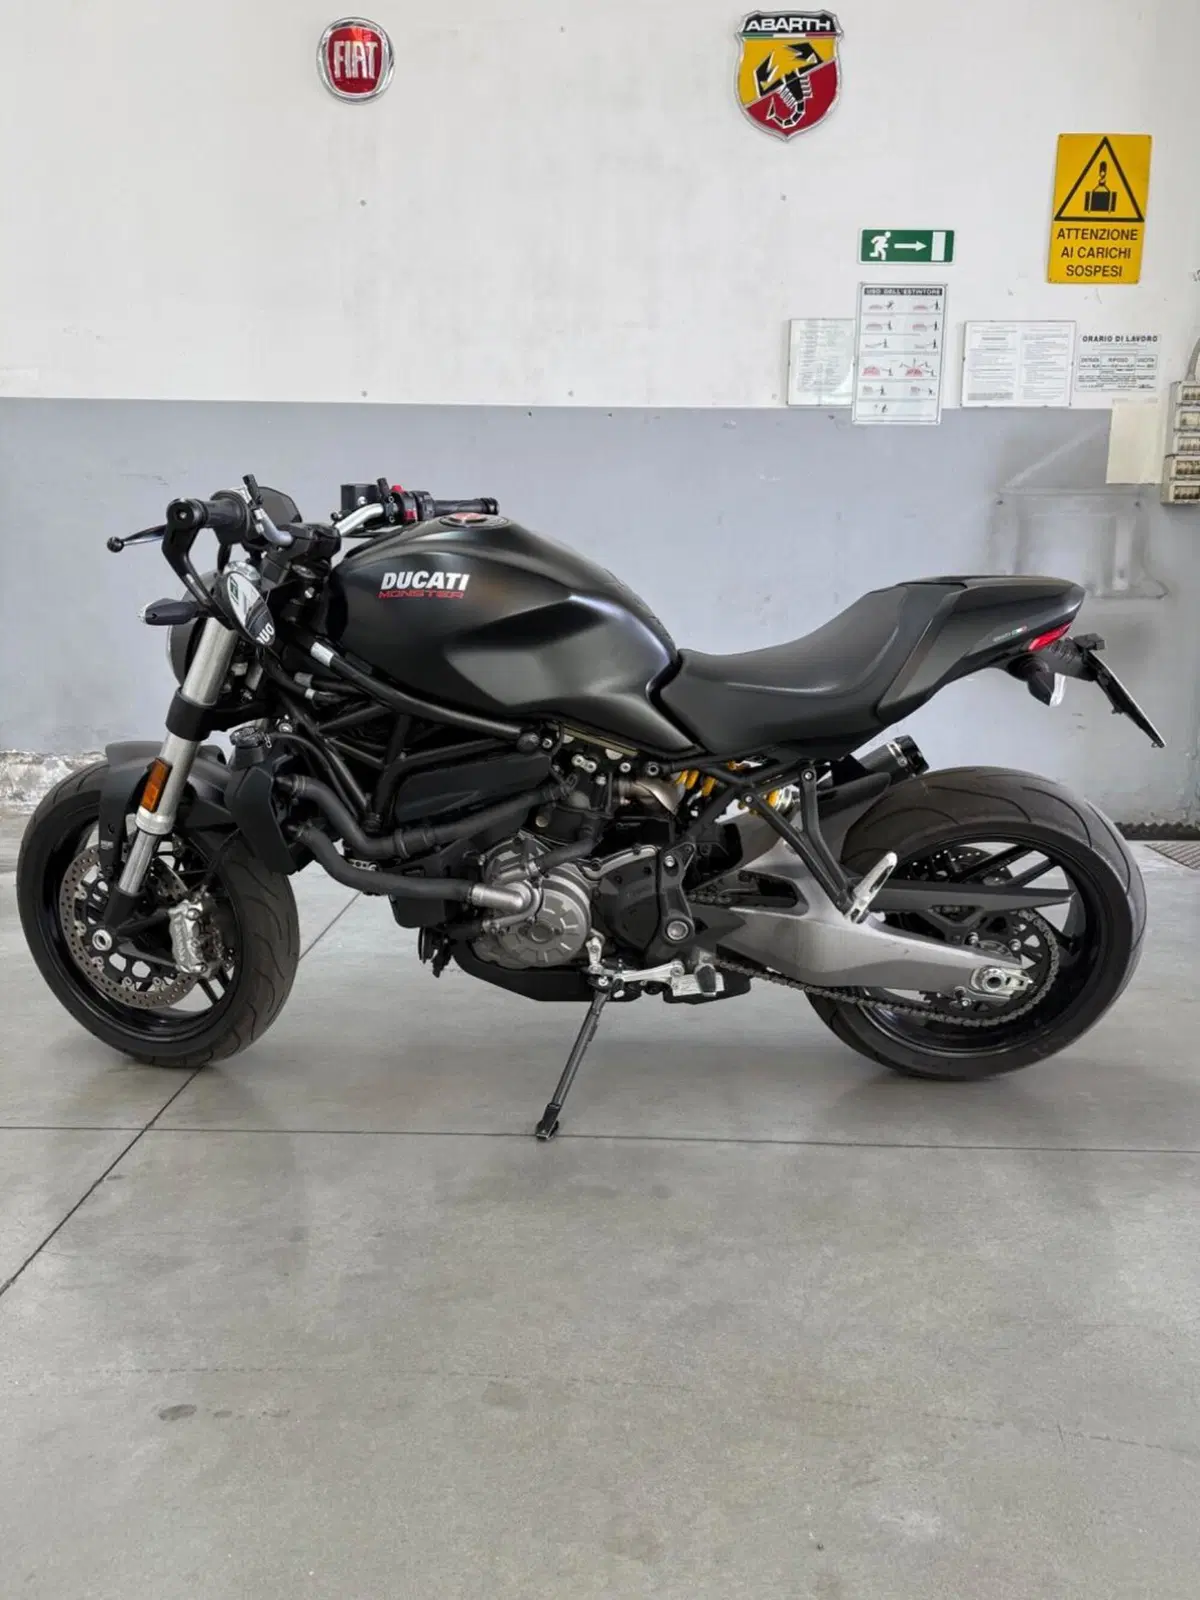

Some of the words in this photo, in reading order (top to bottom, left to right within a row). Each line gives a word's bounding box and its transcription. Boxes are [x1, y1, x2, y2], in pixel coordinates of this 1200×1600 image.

[746, 17, 831, 32] ABARTH
[333, 40, 378, 79] FIAT
[1056, 227, 1138, 241] ATTENZIONE
[1060, 246, 1074, 258] AI
[1077, 246, 1131, 259] CARICHI
[1066, 264, 1123, 277] SOSPESI
[380, 571, 470, 591] DUCATI
[377, 589, 465, 599] MONSTER
